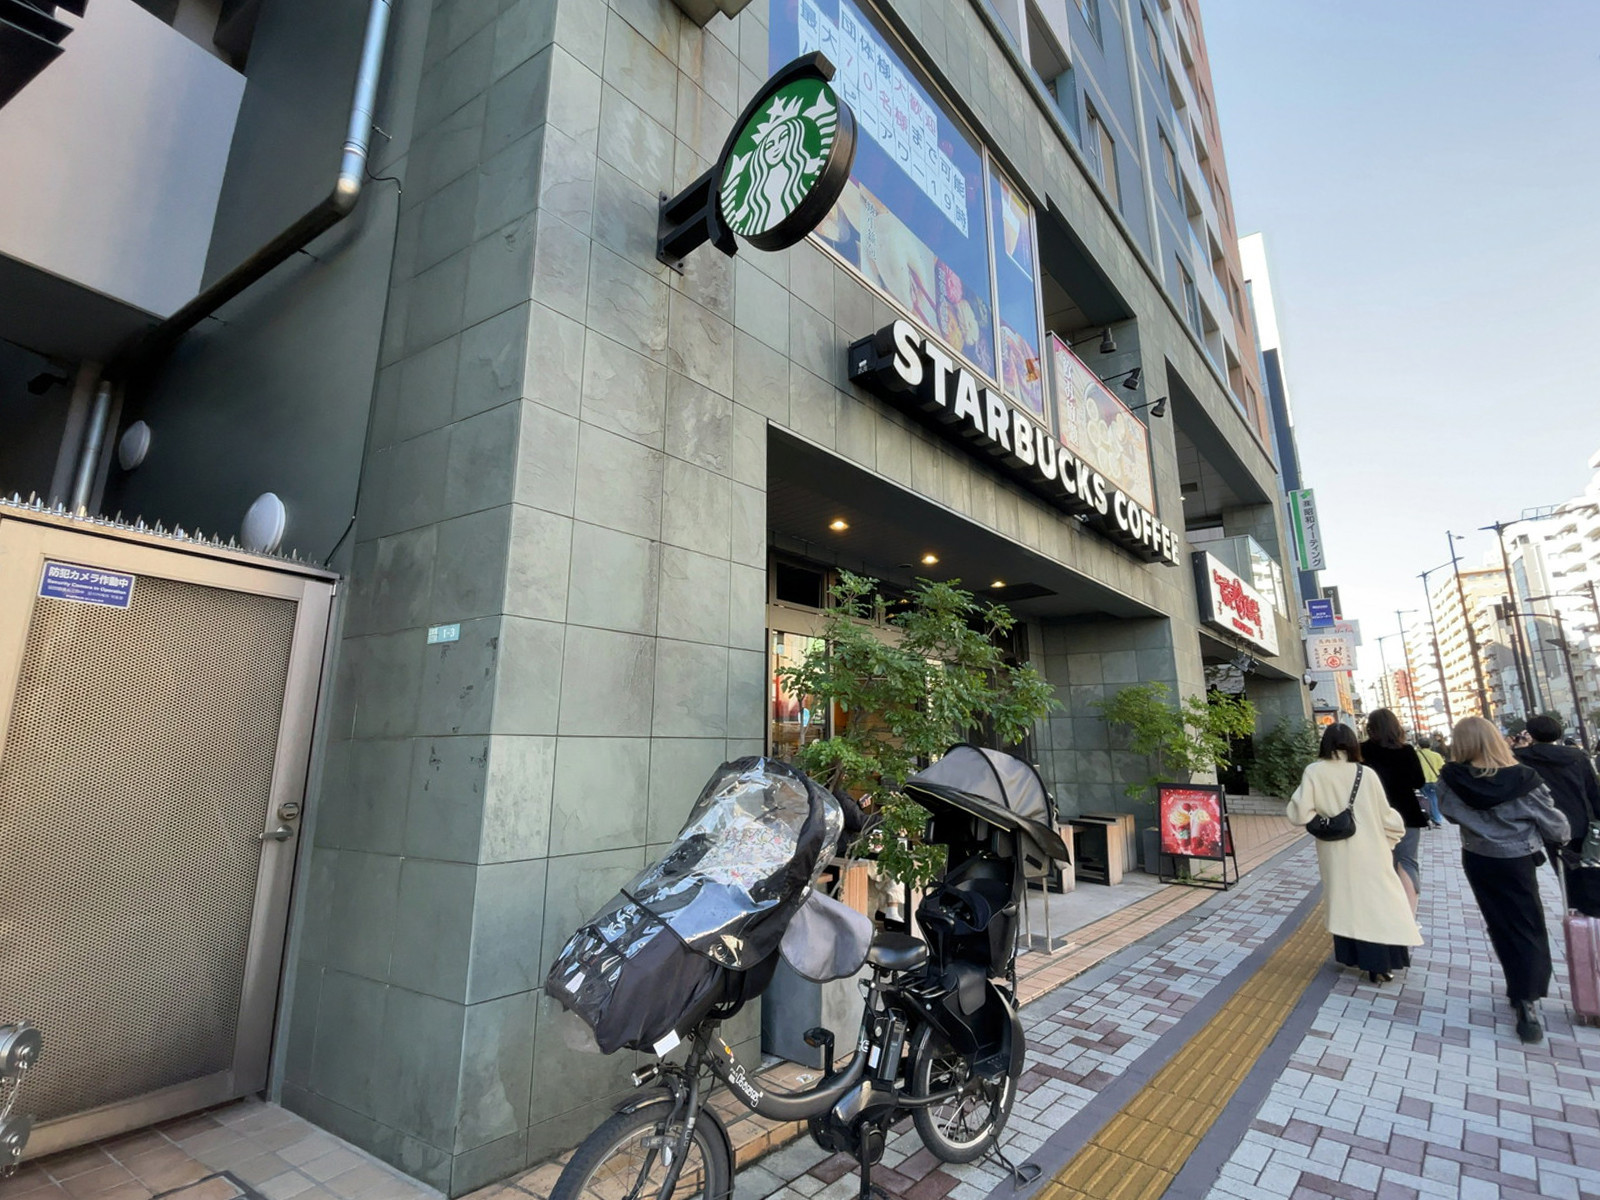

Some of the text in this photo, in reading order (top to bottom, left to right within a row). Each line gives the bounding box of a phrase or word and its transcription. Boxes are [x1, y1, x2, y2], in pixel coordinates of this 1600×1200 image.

[893, 319, 1180, 567] STARBUCKS COFFEE
[49, 567, 128, 588] 防犯カメラ作動中
